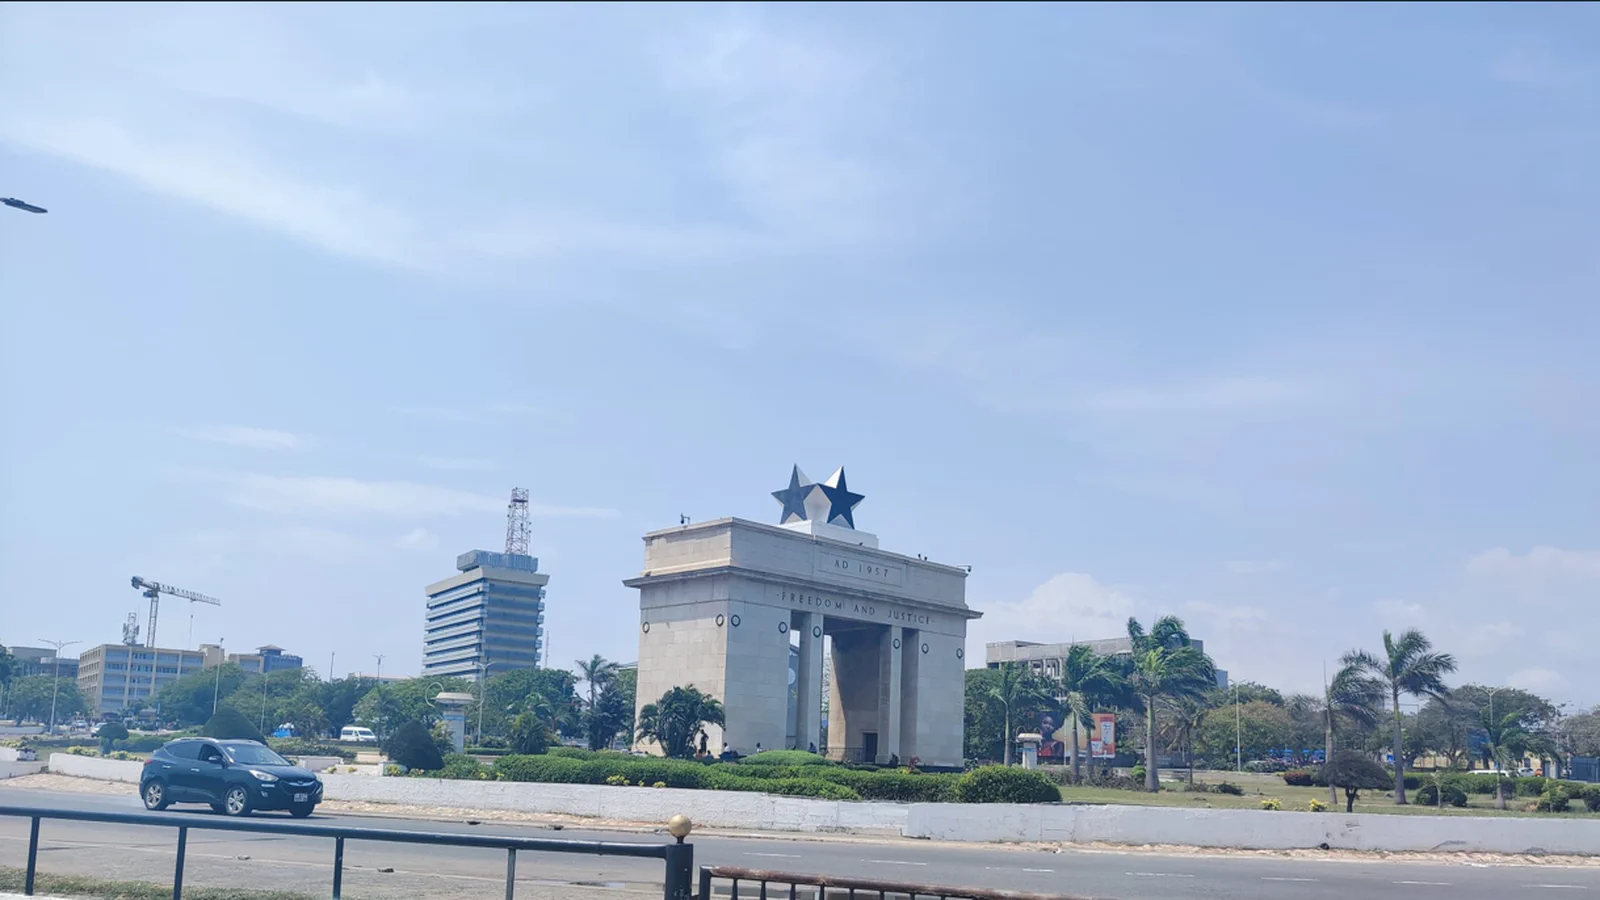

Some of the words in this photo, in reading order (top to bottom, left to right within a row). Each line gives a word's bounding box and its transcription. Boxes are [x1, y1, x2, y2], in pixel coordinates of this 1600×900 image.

[834, 559, 849, 569] AD
[859, 563, 889, 578] 1957
[781, 591, 843, 610] FREEDOM
[853, 604, 876, 616] AND
[887, 609, 930, 625] JUSTICE
